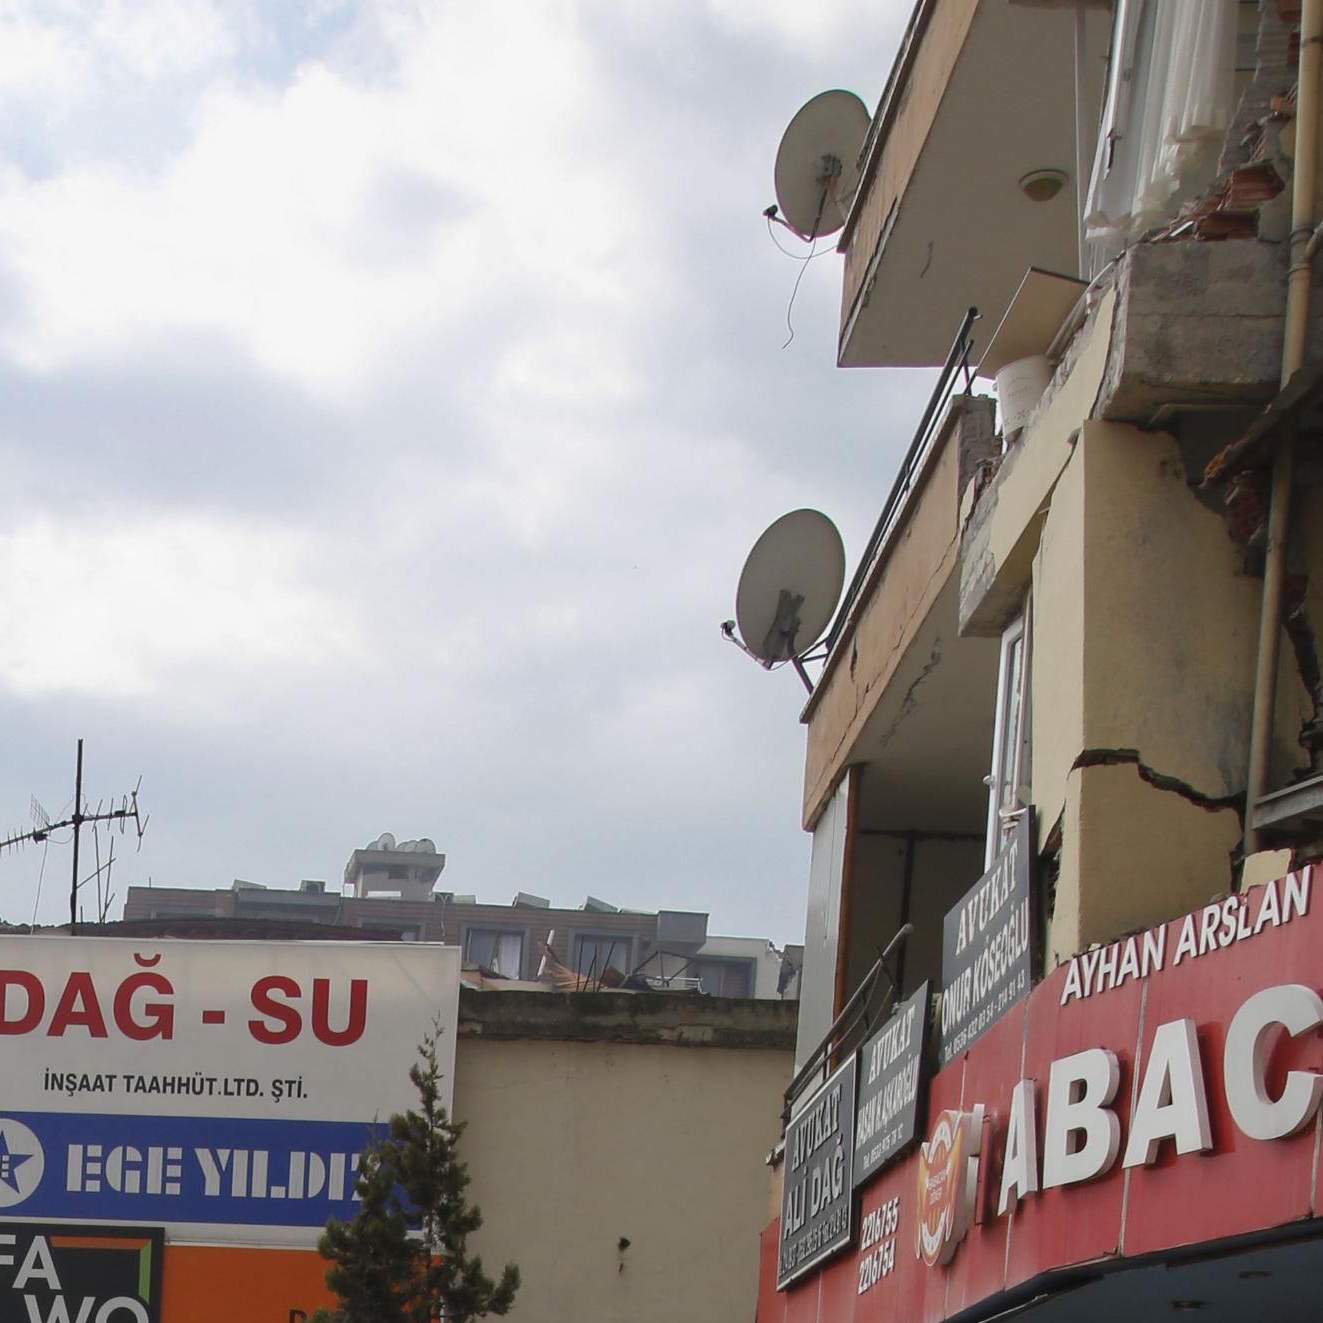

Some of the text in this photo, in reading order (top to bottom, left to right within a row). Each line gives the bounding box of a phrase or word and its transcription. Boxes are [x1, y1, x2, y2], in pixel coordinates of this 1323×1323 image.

[956, 839, 1018, 956] AVUKAT
[1060, 866, 1313, 1006] AYHAN ARSLAN
[248, 976, 368, 1047] SU
[941, 966, 972, 1037] ONUR
[868, 1003, 915, 1085] AVUKAT
[44, 1067, 117, 1098] İNŞAAT
[271, 1076, 309, 1102] ŞTİ.
[791, 1083, 842, 1172] AVUKAT
[67, 1144, 182, 1195] EGE
[784, 1167, 807, 1240] ALİ
[810, 1134, 845, 1218] DAĞ
[861, 1196, 900, 1251] 2216755
[858, 1238, 895, 1295] 2216754
